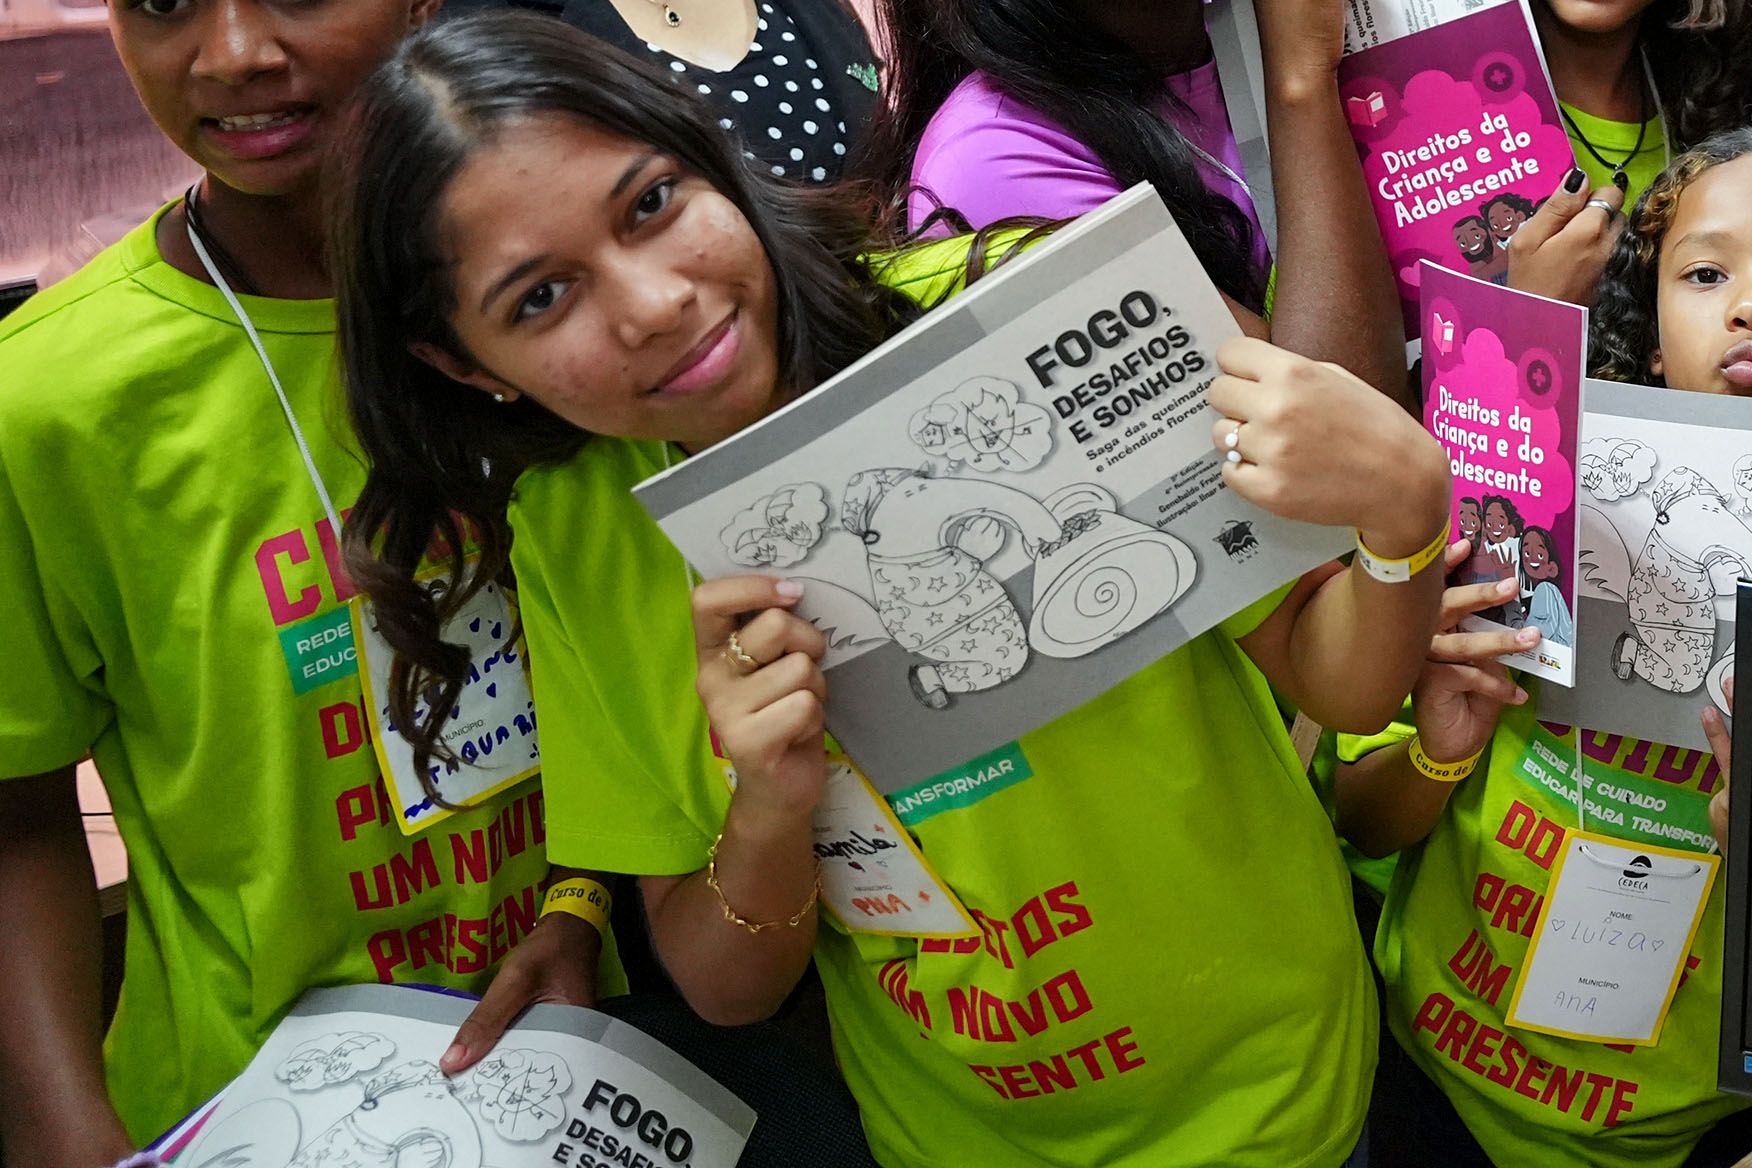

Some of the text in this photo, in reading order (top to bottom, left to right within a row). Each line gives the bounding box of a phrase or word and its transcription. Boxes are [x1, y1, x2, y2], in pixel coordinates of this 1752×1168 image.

[1378, 128, 1531, 200] Criança e do
[1381, 112, 1509, 175] Direitos da
[1394, 157, 1540, 228] Adolescente
[1025, 290, 1172, 389] FOGO,
[1052, 325, 1190, 419] DESAFIOS
[1068, 350, 1205, 444] E SONHOS
[1439, 385, 1531, 433] Direitos da
[1086, 436, 1120, 461] Saga
[1125, 421, 1147, 438] das
[1096, 398, 1210, 472] e incêndios florest
[1433, 409, 1544, 464] Criança e do
[296, 622, 352, 656] REDE
[894, 759, 1015, 815] ANSFORMAR
[1416, 754, 1469, 777] Curso de
[1523, 757, 1624, 826] EDUCAR PARA
[1532, 740, 1569, 773] REDE
[1596, 781, 1667, 812] CUIDADO
[349, 837, 441, 911] UM
[549, 885, 602, 907] Curso de
[1618, 877, 1649, 890] CEDECA
[1609, 911, 1633, 921] NOME
[1448, 928, 1513, 1007] UM
[1578, 977, 1620, 990] MUNICÍPIO
[946, 968, 1094, 1043] NOVO
[1413, 992, 1639, 1128] PRESENTE
[552, 1142, 574, 1165] E
